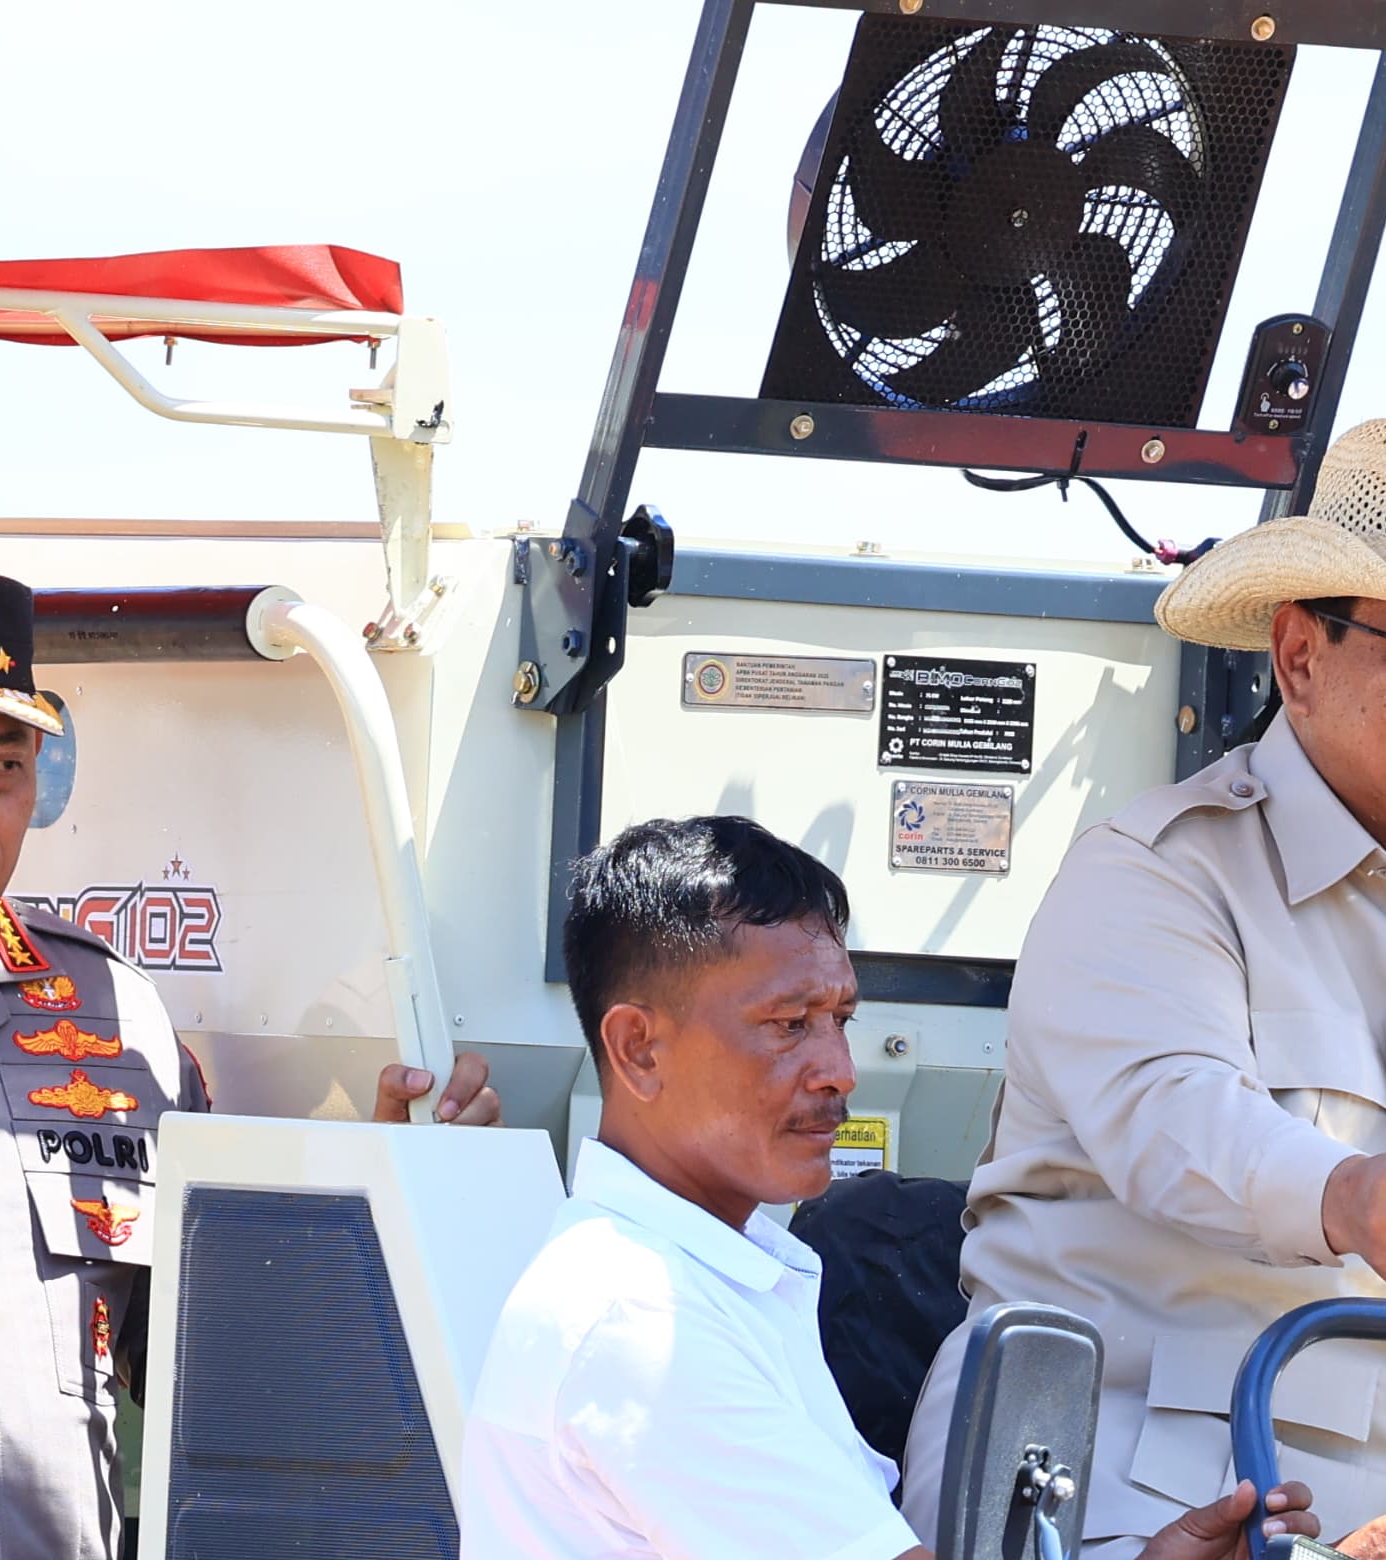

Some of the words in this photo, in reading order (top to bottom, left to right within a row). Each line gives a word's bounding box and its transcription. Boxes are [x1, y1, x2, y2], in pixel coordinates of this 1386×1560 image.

[916, 667, 964, 688] BIMO
[909, 737, 921, 746] PT
[921, 738, 947, 748] CORIN
[947, 739, 971, 749] MULIA
[972, 740, 1013, 751] GEMILANG
[910, 786, 937, 795] CORIN
[939, 788, 964, 797] MULIA
[898, 832, 924, 840] corin
[895, 845, 955, 855] SPAREPARTS
[957, 847, 964, 855] &
[967, 848, 1006, 857] SERVICE
[915, 856, 939, 864] 0811
[942, 857, 960, 865] 300
[962, 858, 986, 867] 6500
[835, 1127, 877, 1142] erhatian
[37, 1129, 149, 1173] POLRI
